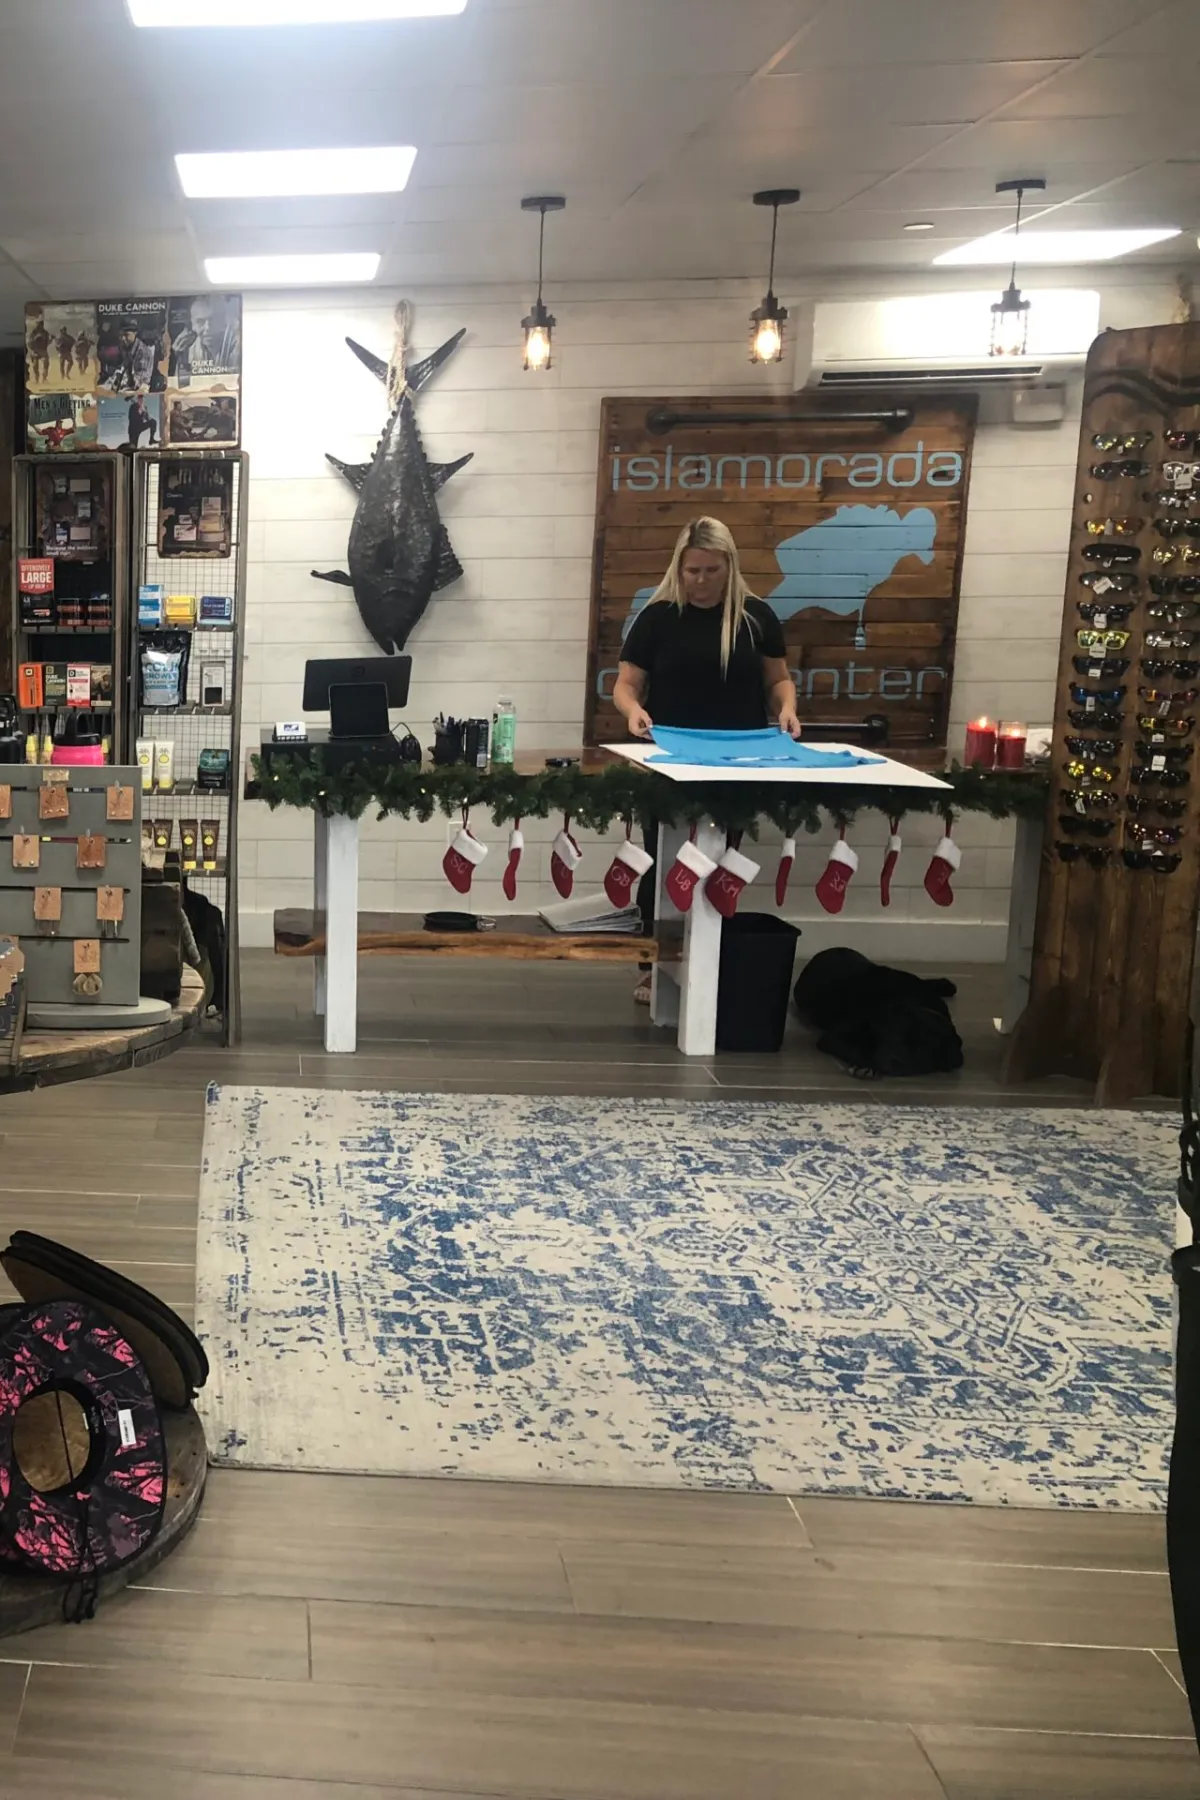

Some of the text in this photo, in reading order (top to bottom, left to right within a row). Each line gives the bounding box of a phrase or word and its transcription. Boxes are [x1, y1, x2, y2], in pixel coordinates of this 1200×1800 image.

[98, 302, 165, 312] DUKE CANNON
[611, 440, 963, 491] islamorada
[21, 572, 52, 583] LARGE
[790, 661, 947, 701] nter
